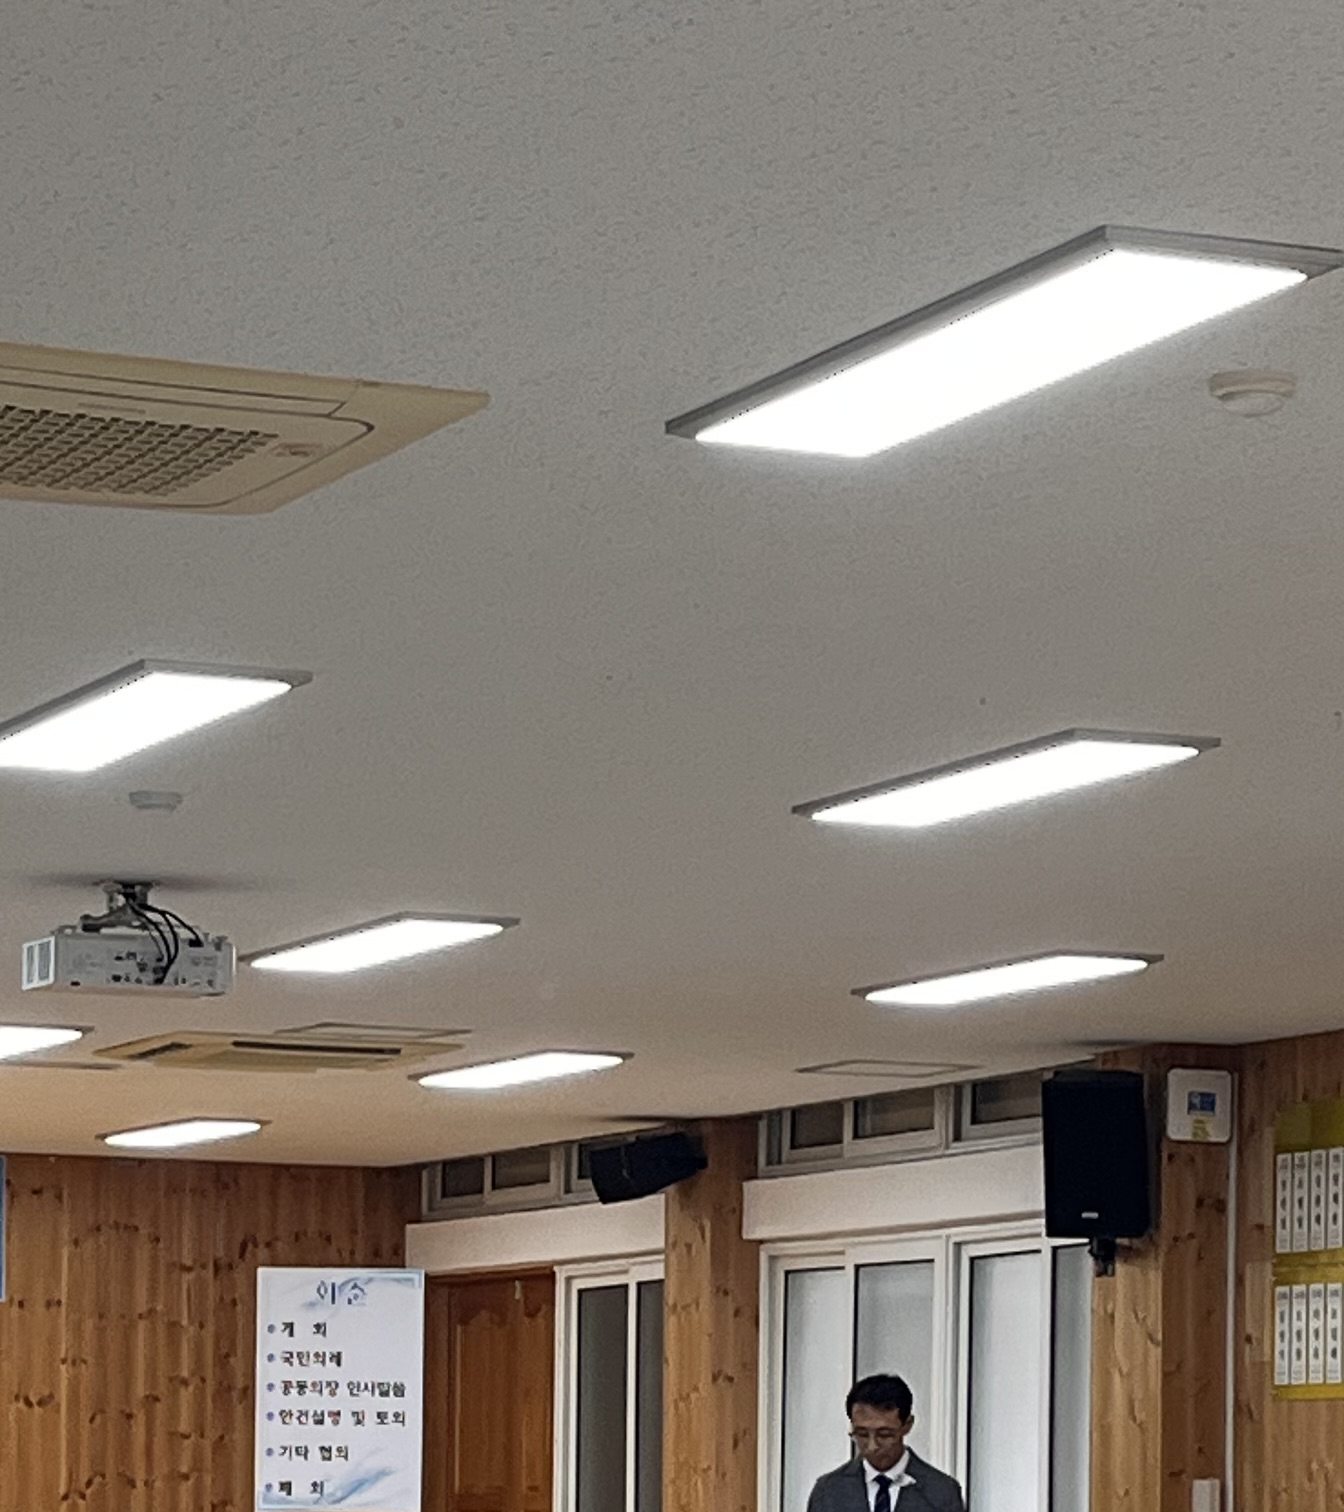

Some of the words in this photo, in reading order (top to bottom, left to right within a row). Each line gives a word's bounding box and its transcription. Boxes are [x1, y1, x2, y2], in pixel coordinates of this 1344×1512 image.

[279, 1350, 343, 1368] 국민의례
[346, 1379, 407, 1398] 인사말씀
[278, 1408, 342, 1426] 안건설명
[351, 1409, 366, 1427] 및
[375, 1410, 406, 1427] 토의
[278, 1444, 309, 1461] 기타
[317, 1444, 349, 1462] 협의
